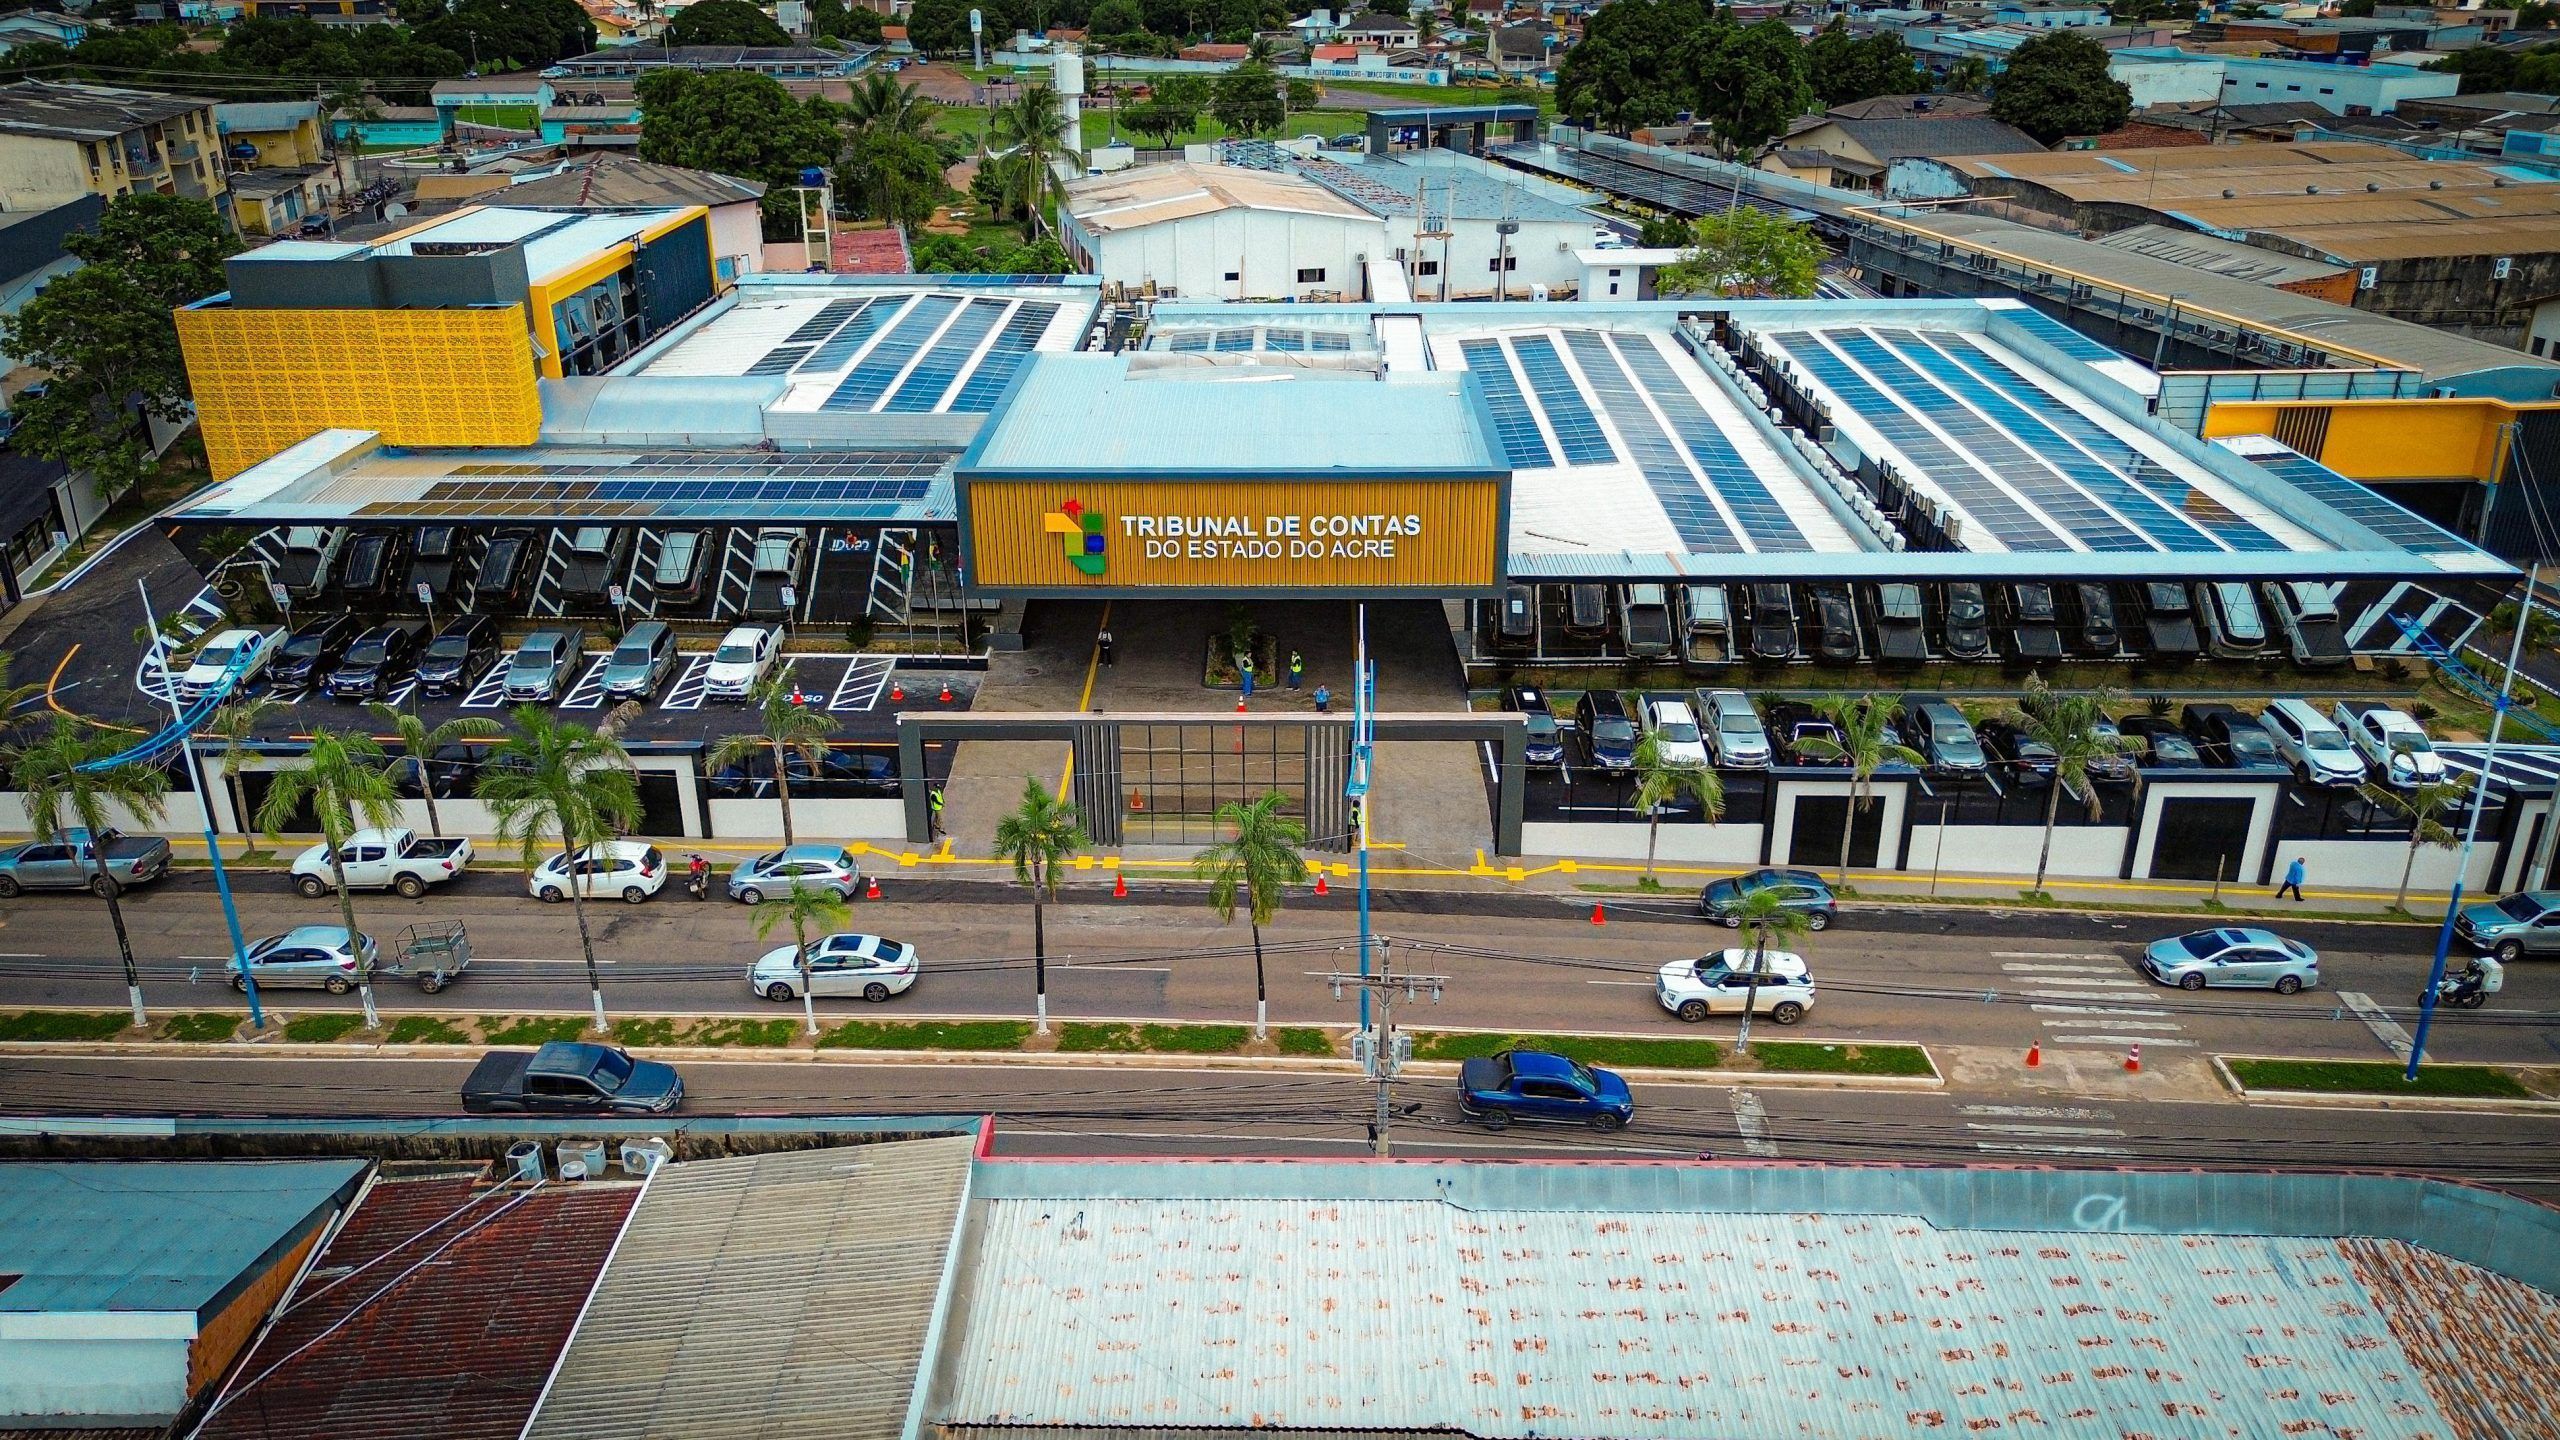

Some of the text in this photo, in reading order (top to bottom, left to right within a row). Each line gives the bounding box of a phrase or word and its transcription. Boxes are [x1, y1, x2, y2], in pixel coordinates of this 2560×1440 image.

[1120, 515, 1421, 537] TRIBUNAL DE CONTAS
[1146, 539, 1395, 558] DO ESTADO DO ACRE
